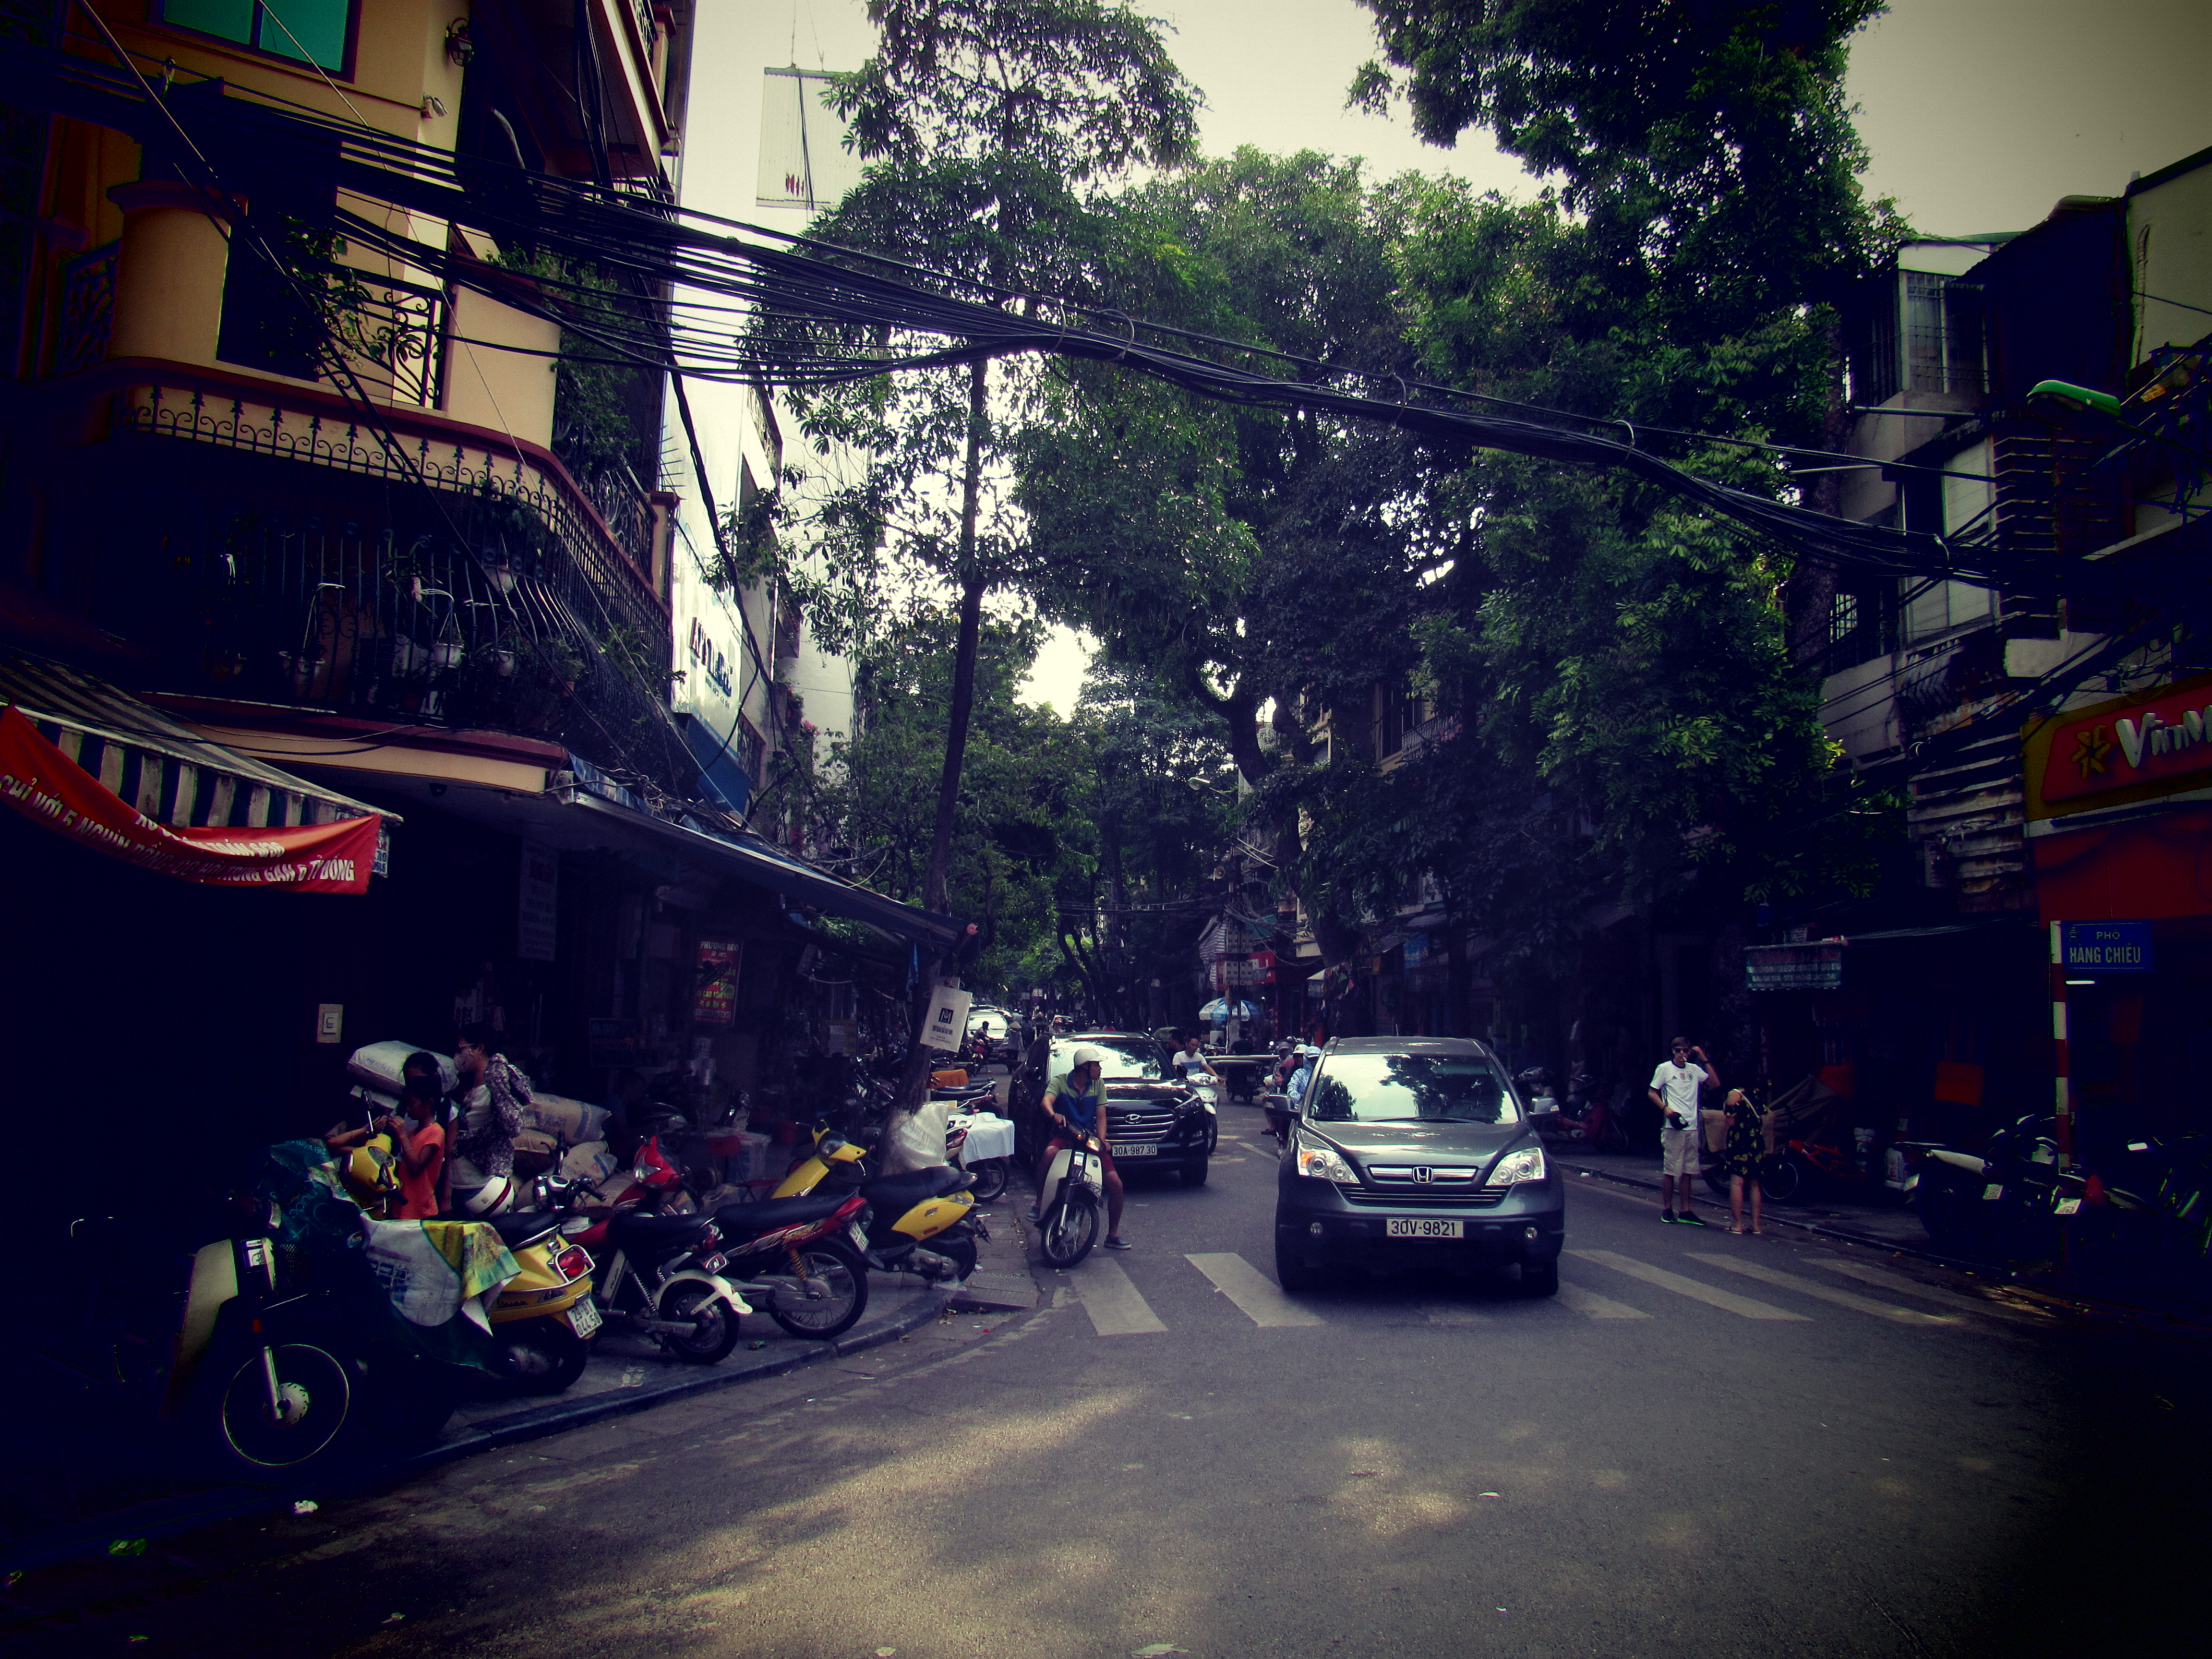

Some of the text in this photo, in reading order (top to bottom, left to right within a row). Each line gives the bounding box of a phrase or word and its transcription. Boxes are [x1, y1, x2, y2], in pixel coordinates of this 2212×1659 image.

[61, 809, 78, 829] 5
[2096, 928, 2121, 940] PHỐ
[2069, 941, 2141, 963] HÀNG CHIẾU
[1113, 1145, 1156, 1155] 30A-987.30
[1391, 1220, 1455, 1236] 30V-9821
